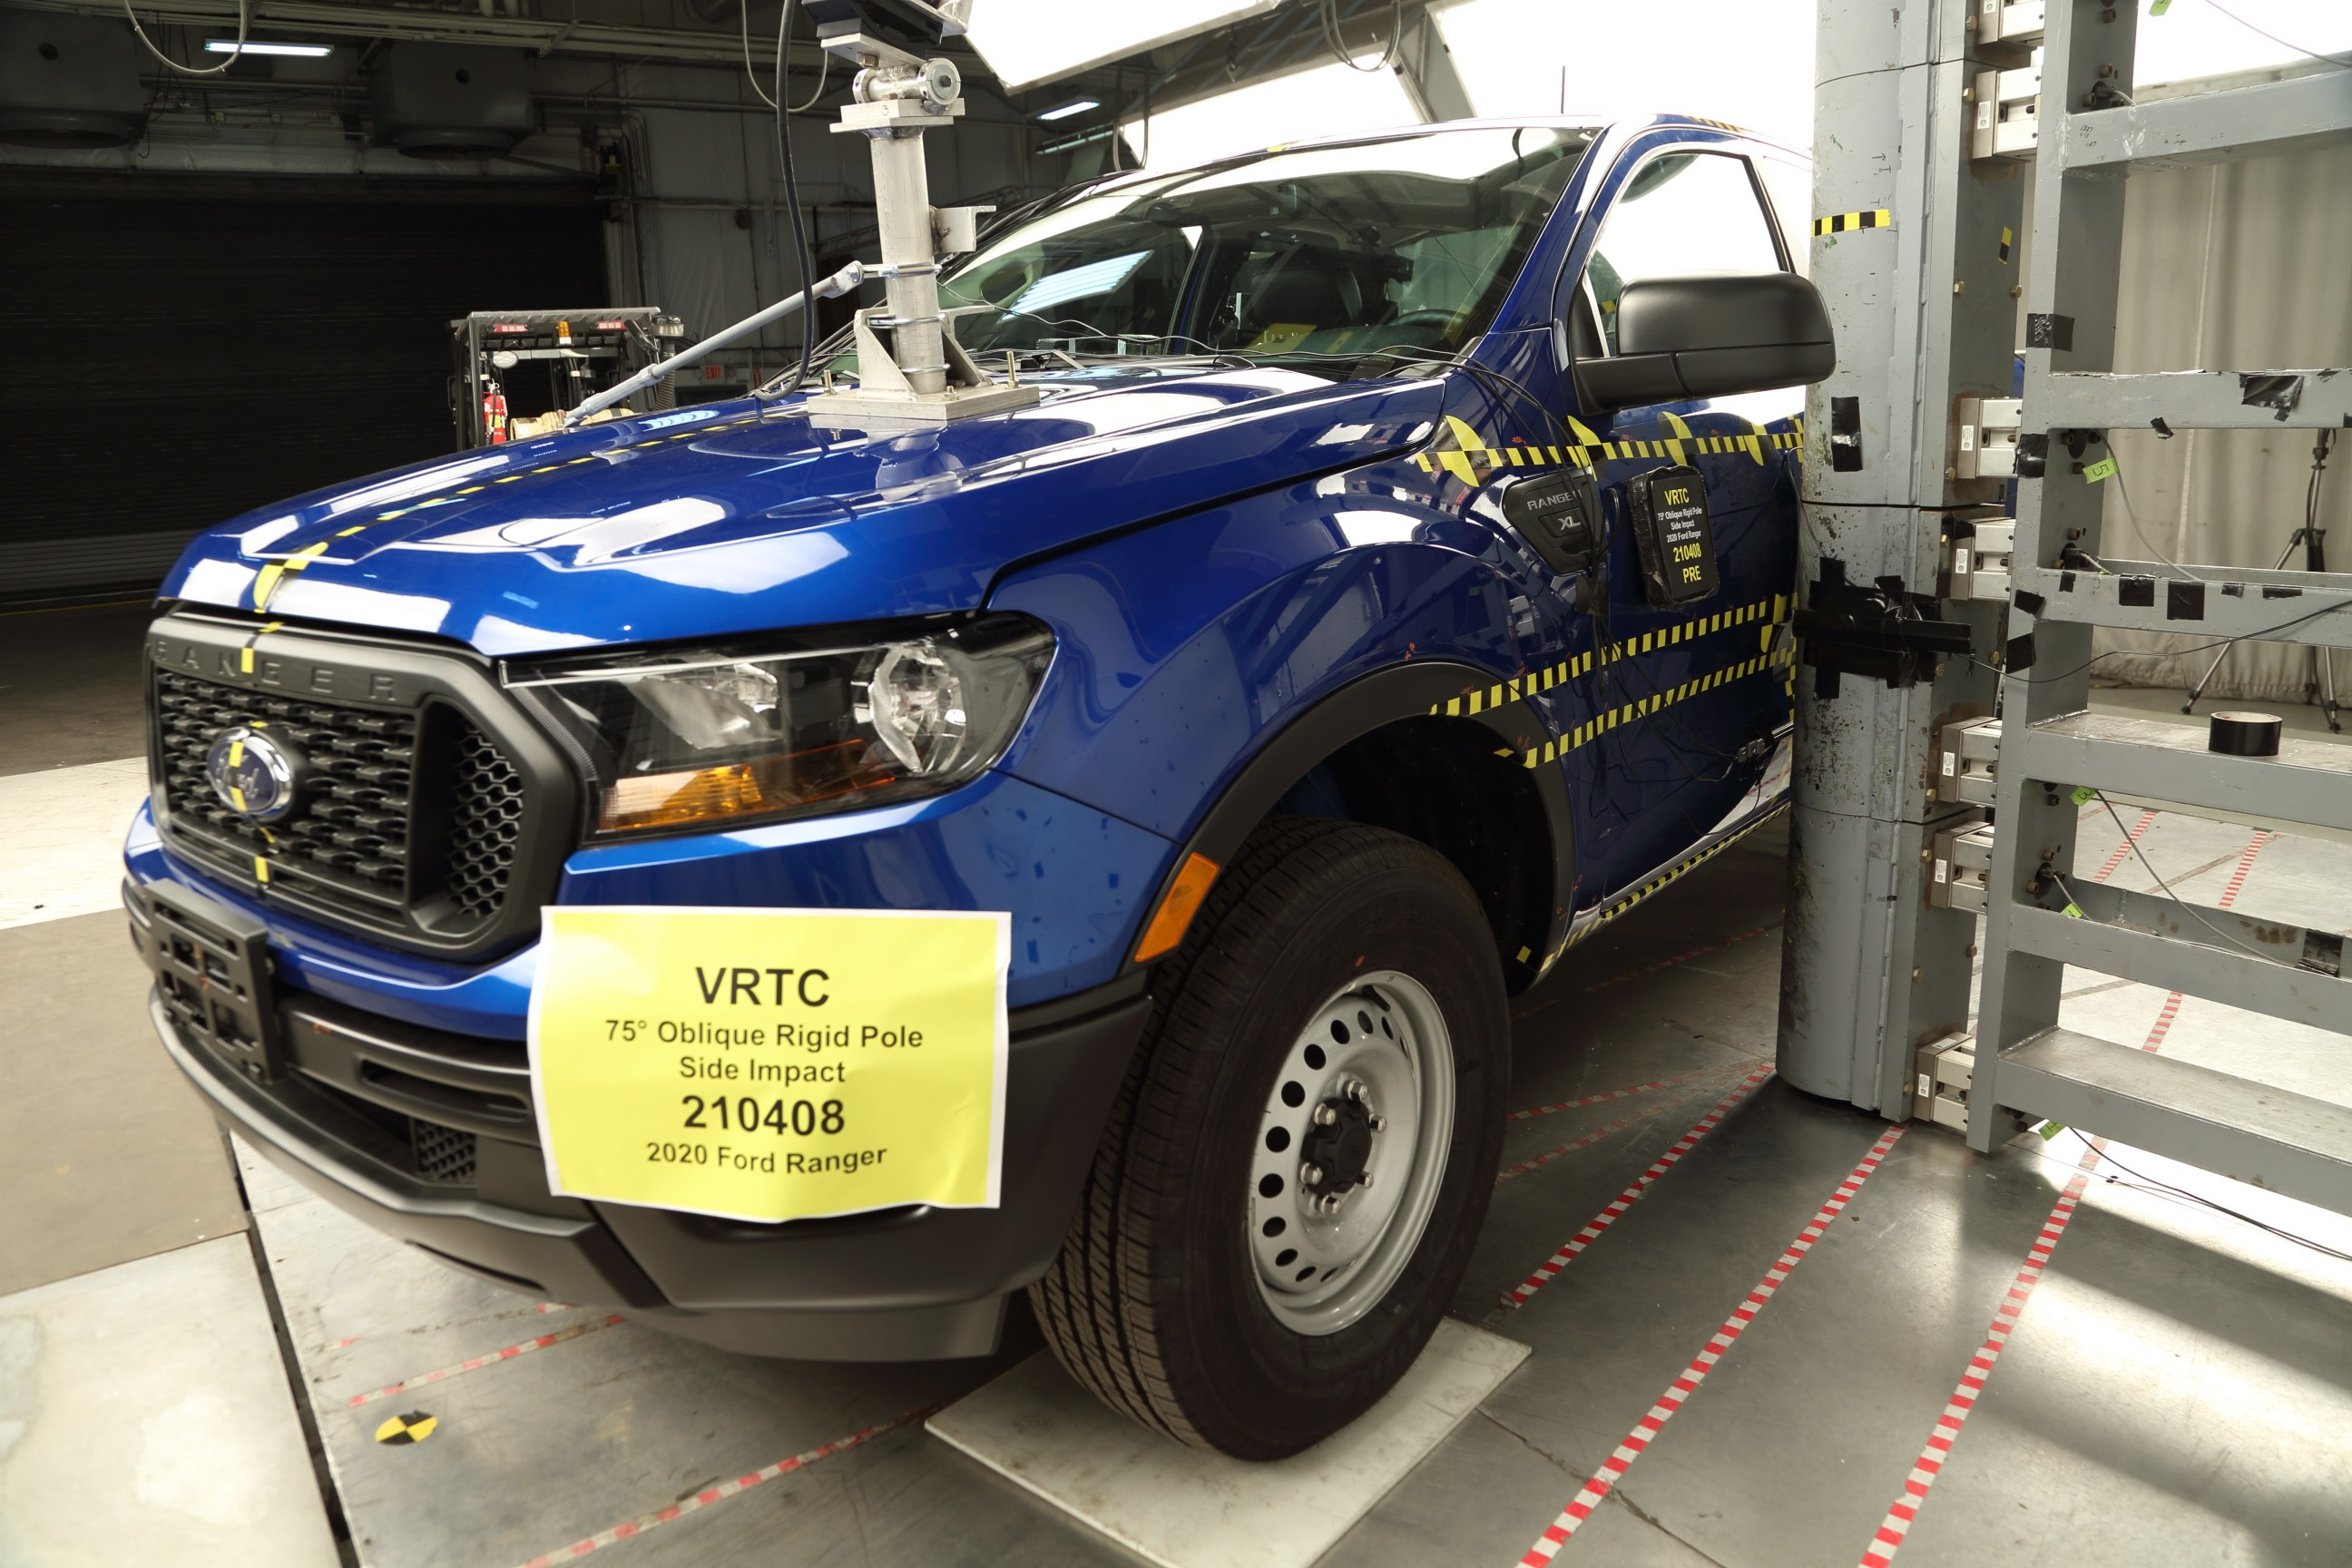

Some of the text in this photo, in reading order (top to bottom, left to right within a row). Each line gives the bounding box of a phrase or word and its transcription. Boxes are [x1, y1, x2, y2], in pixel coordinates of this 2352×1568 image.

[706, 366, 721, 378] EXIT
[2092, 464, 2110, 476] 5
[1664, 487, 1690, 505] VRTC
[1665, 510, 1683, 520] Oblique
[1682, 507, 1694, 518] Rigid
[1693, 506, 1702, 514] Pole
[1557, 515, 1582, 531] XL
[1671, 519, 1695, 531] Side Impact
[1667, 530, 1701, 543] 2020 Ford Ranger
[1673, 544, 1701, 563] 210408
[1682, 565, 1702, 583] PRE
[696, 966, 829, 1007] VRTC
[605, 1020, 924, 1054] 75° Oblique Rigid Pole
[680, 1056, 846, 1087] Side Impact
[681, 1095, 846, 1136] 210408
[646, 1142, 888, 1175] 2020 Ford Ranger
